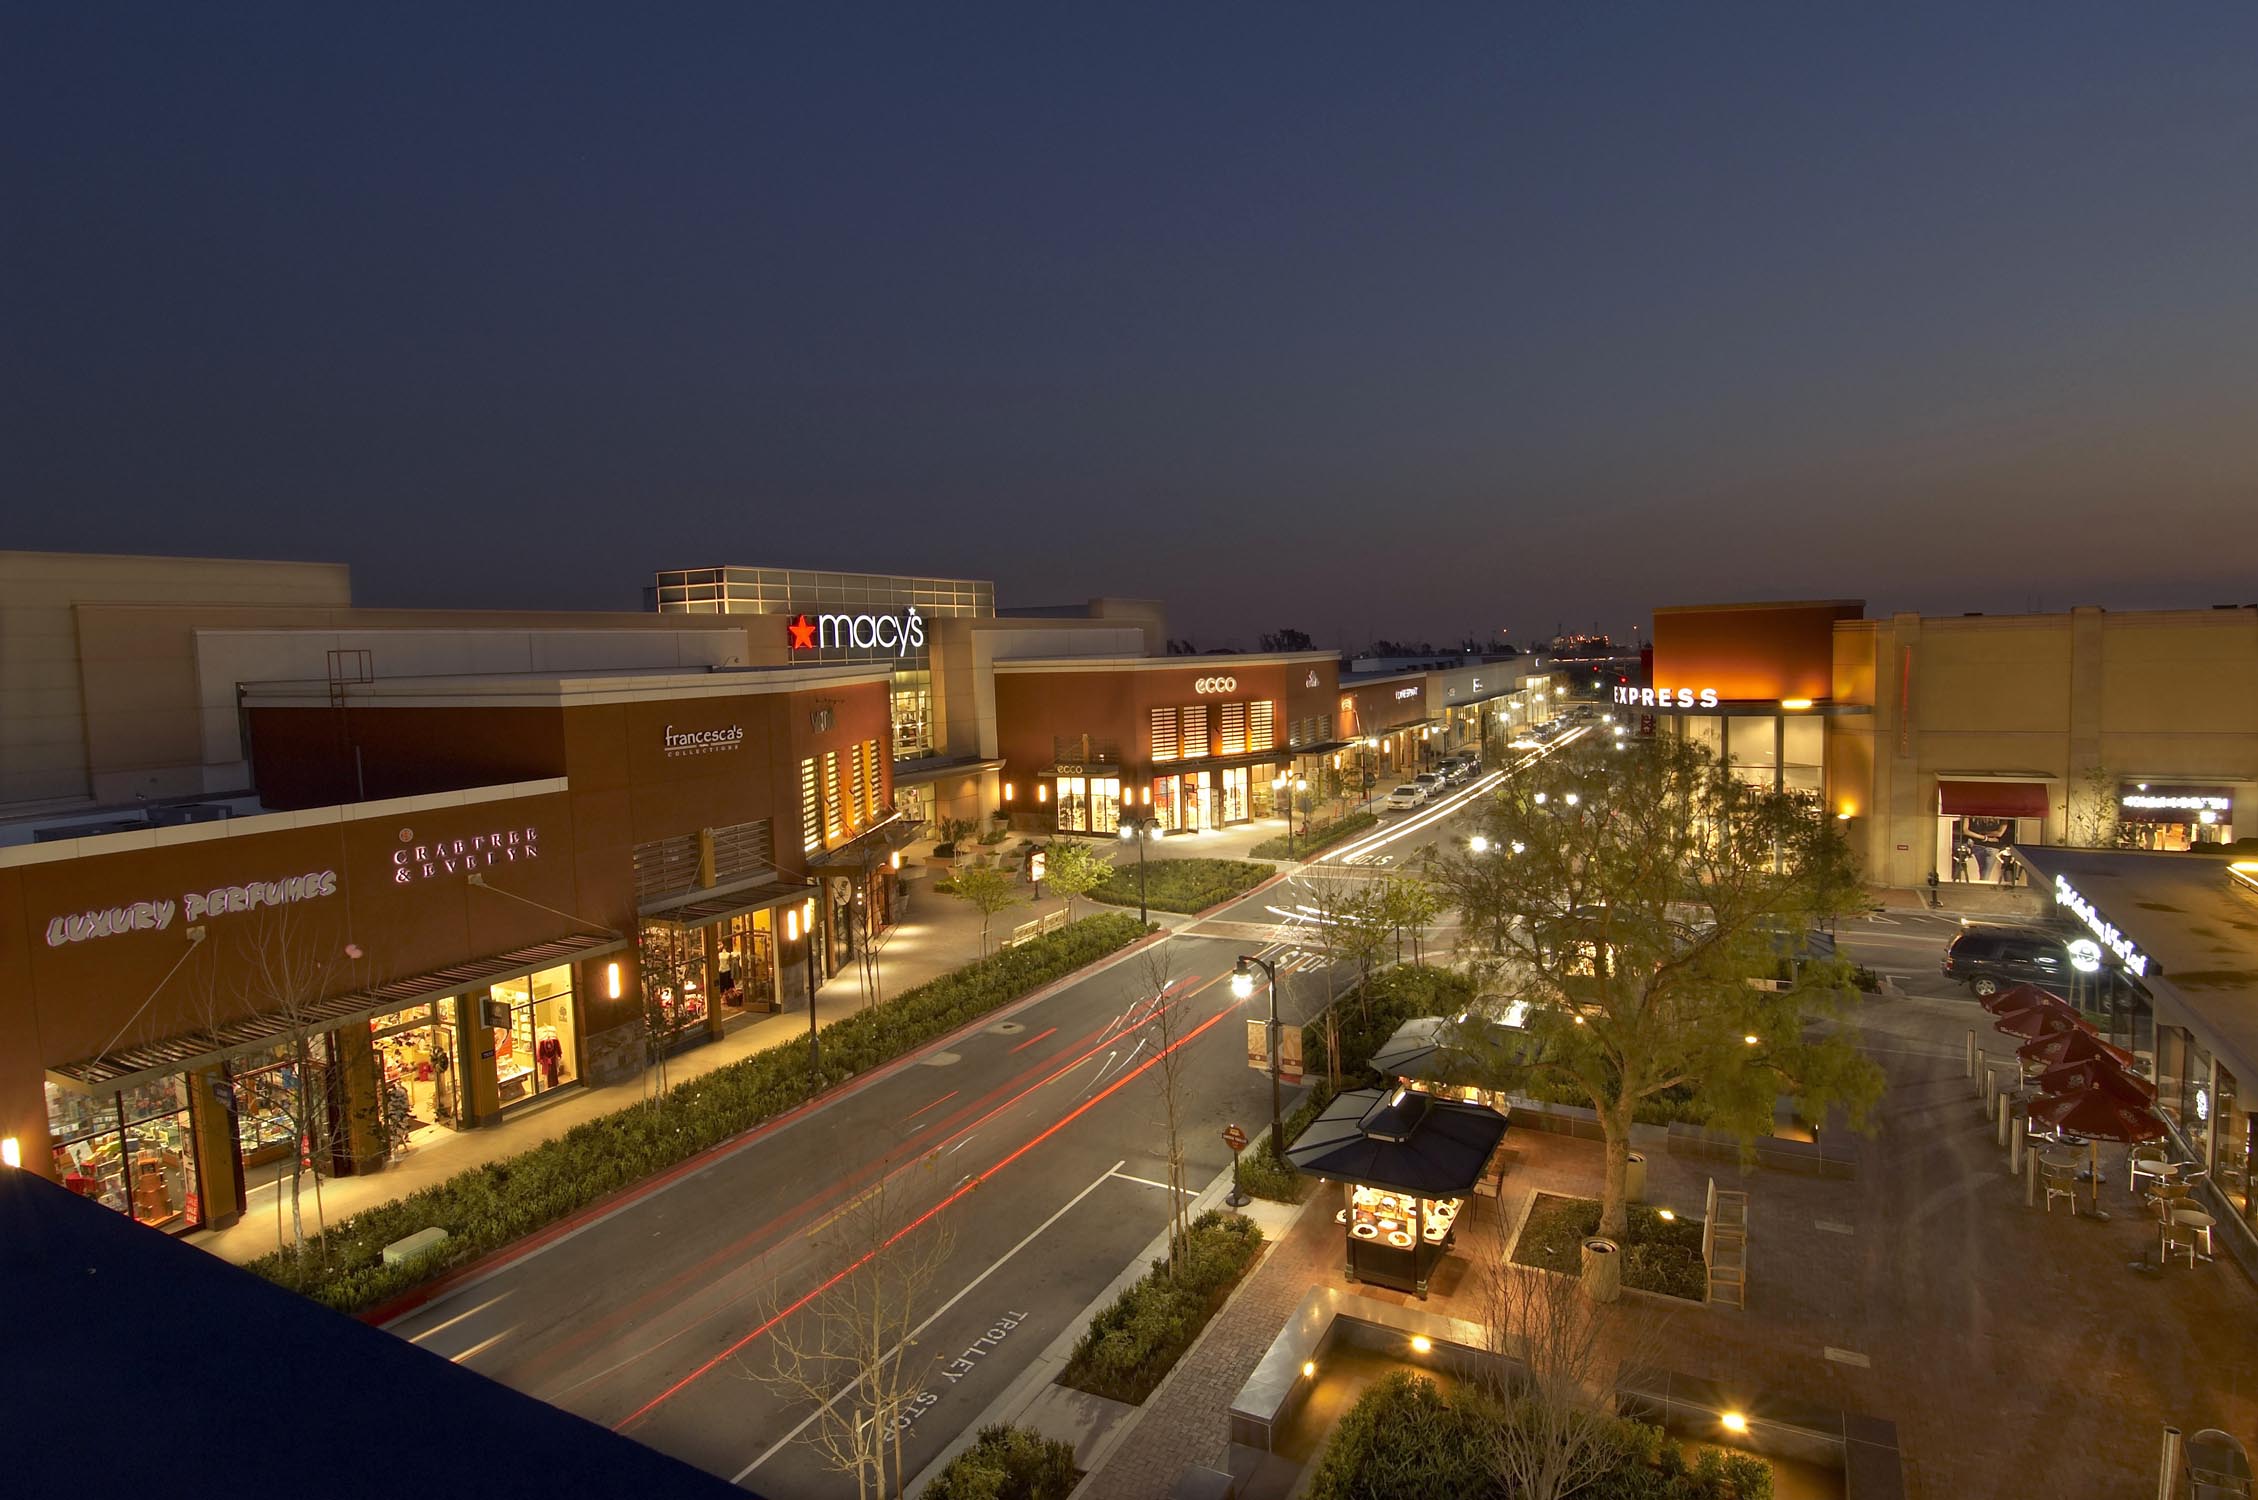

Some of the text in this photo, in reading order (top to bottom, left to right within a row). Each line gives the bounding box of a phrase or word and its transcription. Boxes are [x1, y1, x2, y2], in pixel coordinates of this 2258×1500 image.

[1195, 676, 1237, 694] ecco
[1613, 686, 1718, 708] EXPRESS
[665, 725, 743, 747] francesca's
[1057, 765, 1083, 774] ecco
[393, 827, 538, 866] CRABTREE
[395, 844, 539, 884] & EVELYN
[46, 870, 337, 947] LUXURY PERFUMES
[941, 1310, 1029, 1383] TROLLEY
